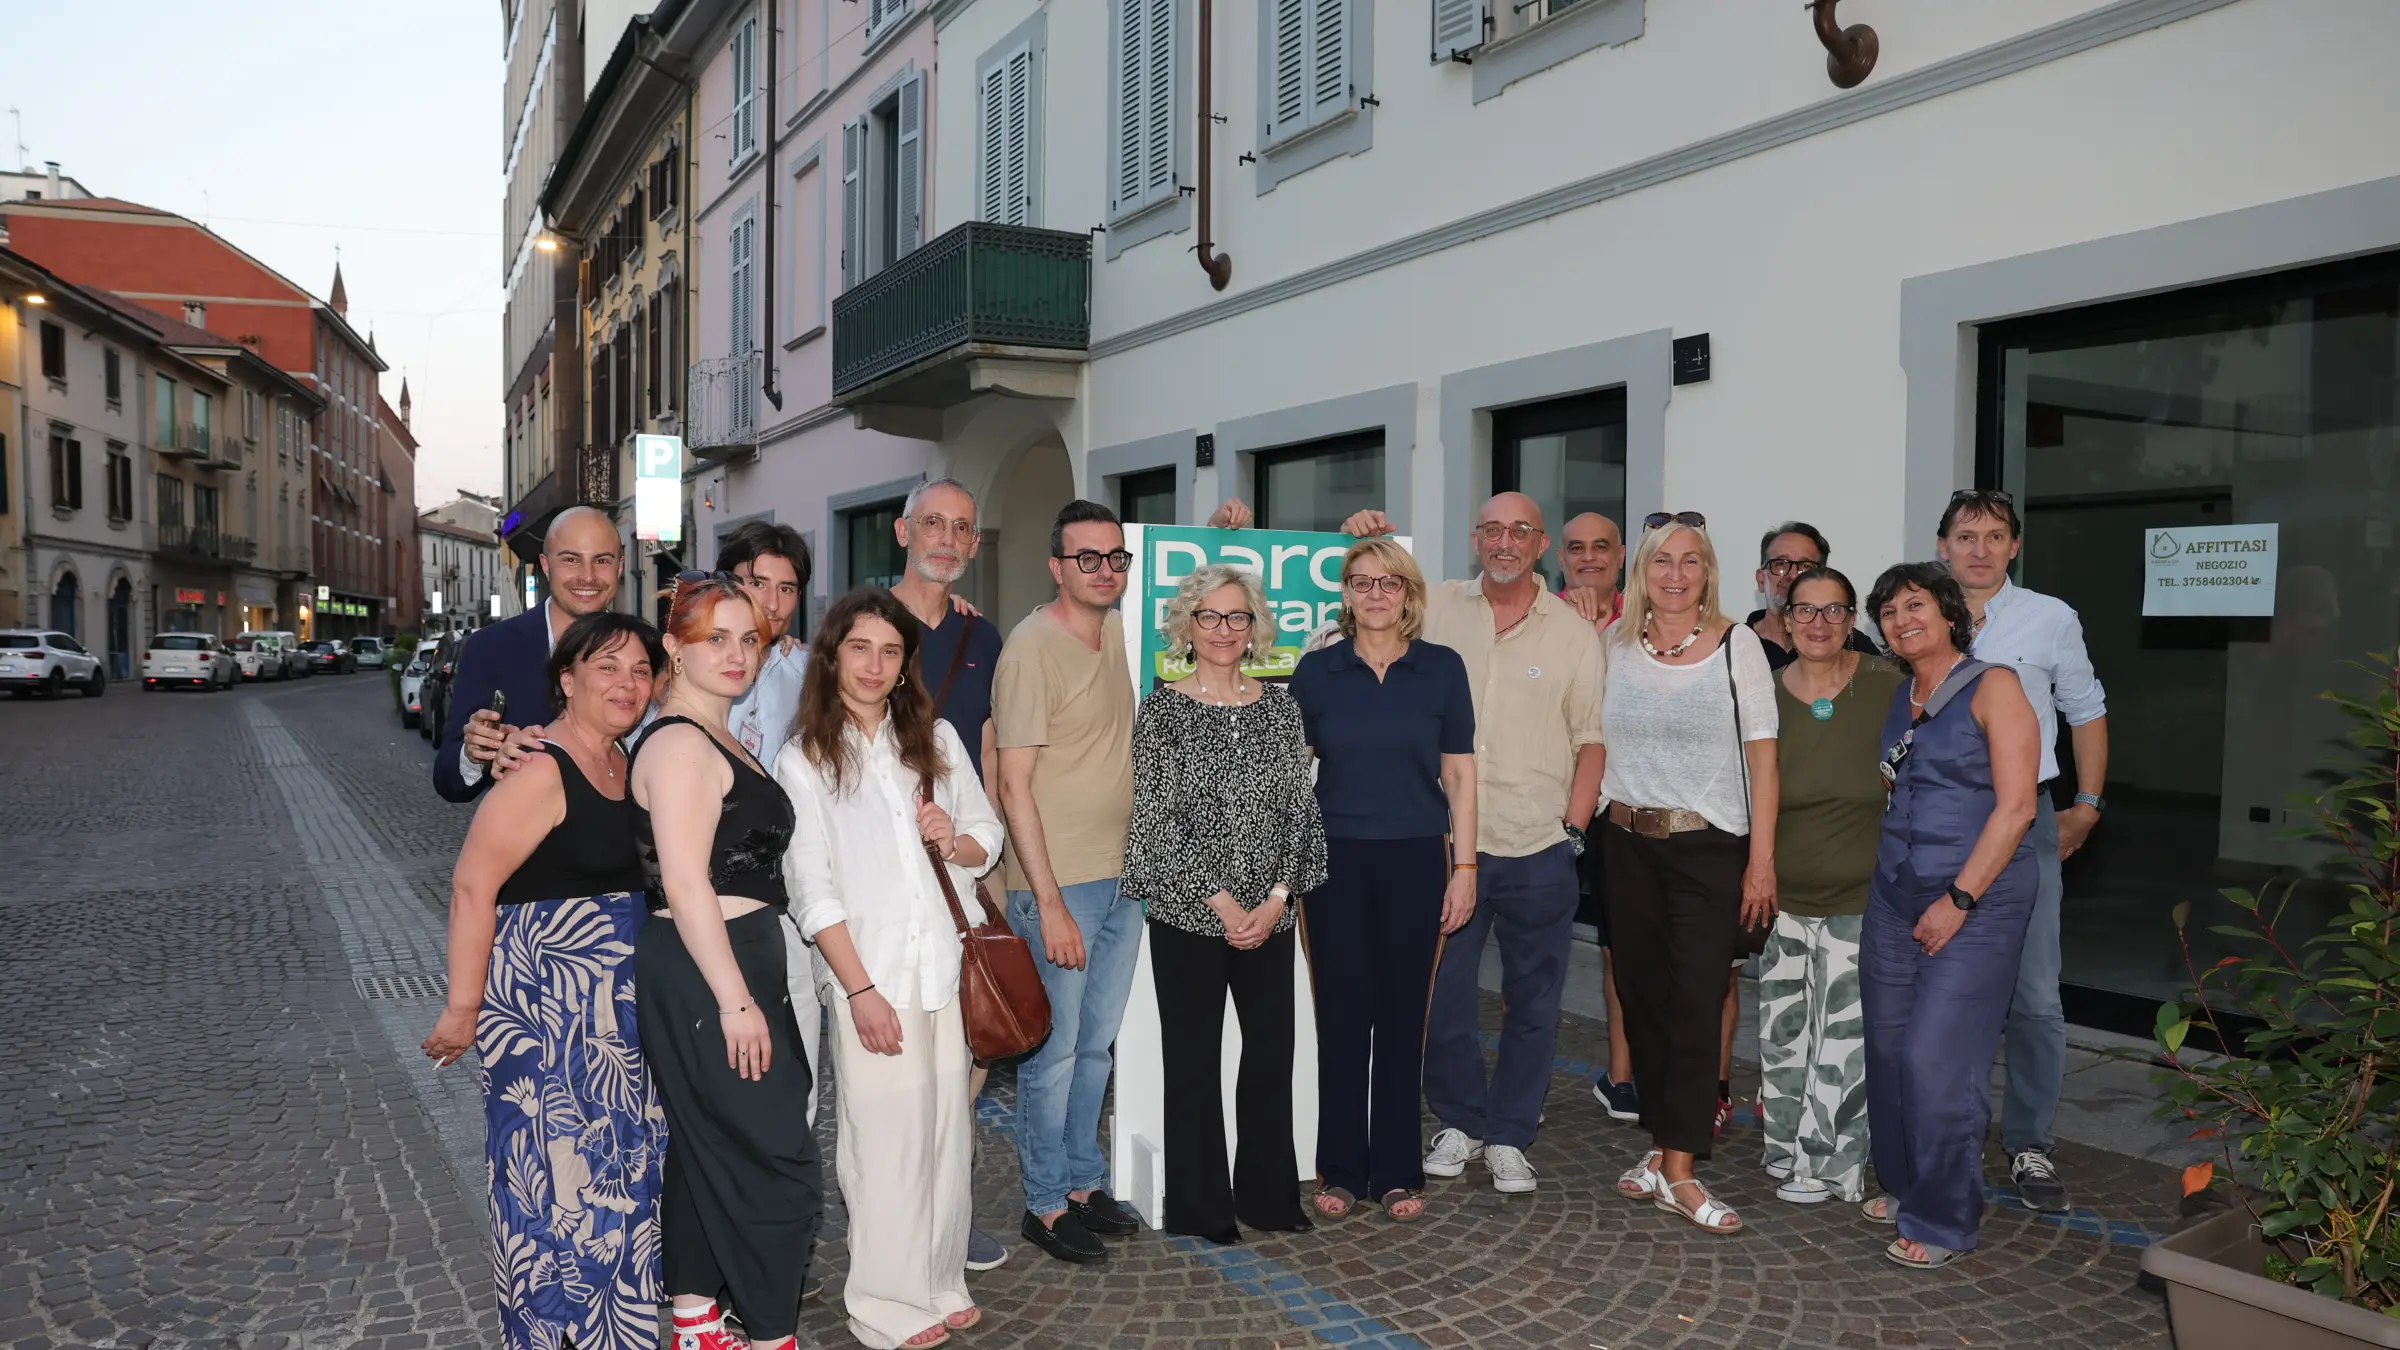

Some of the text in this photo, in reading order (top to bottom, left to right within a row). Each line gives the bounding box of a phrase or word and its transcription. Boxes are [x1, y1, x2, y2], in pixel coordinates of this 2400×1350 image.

[644, 439, 674, 476] P
[2185, 539, 2268, 554] AFFITTASI
[2196, 560, 2248, 570] NEGOZIO
[2158, 576, 2250, 587] TEL. 3758402304
